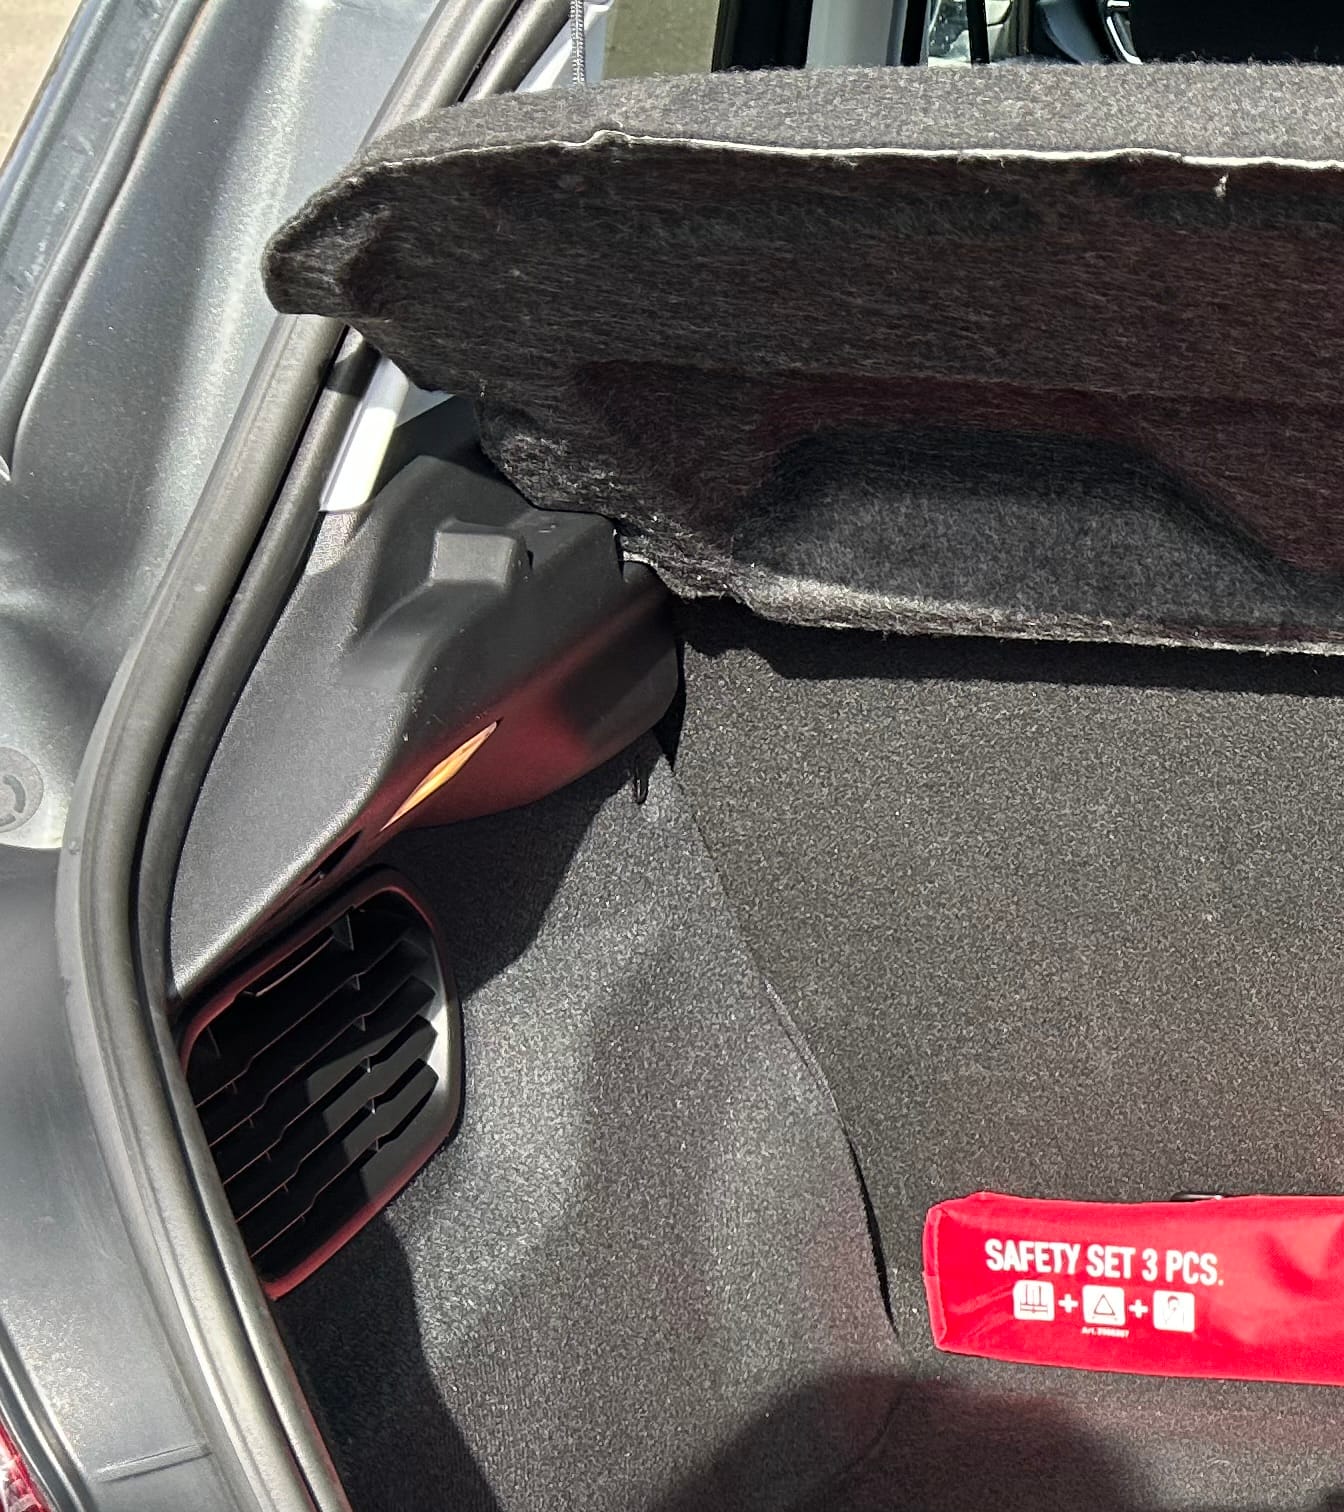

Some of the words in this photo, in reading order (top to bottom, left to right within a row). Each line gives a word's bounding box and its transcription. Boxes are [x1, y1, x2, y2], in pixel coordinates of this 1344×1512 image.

[984, 1238, 1081, 1275] SAFETY
[1086, 1243, 1136, 1279] SET
[1141, 1248, 1158, 1282] 3
[1165, 1249, 1224, 1287] PCS.
